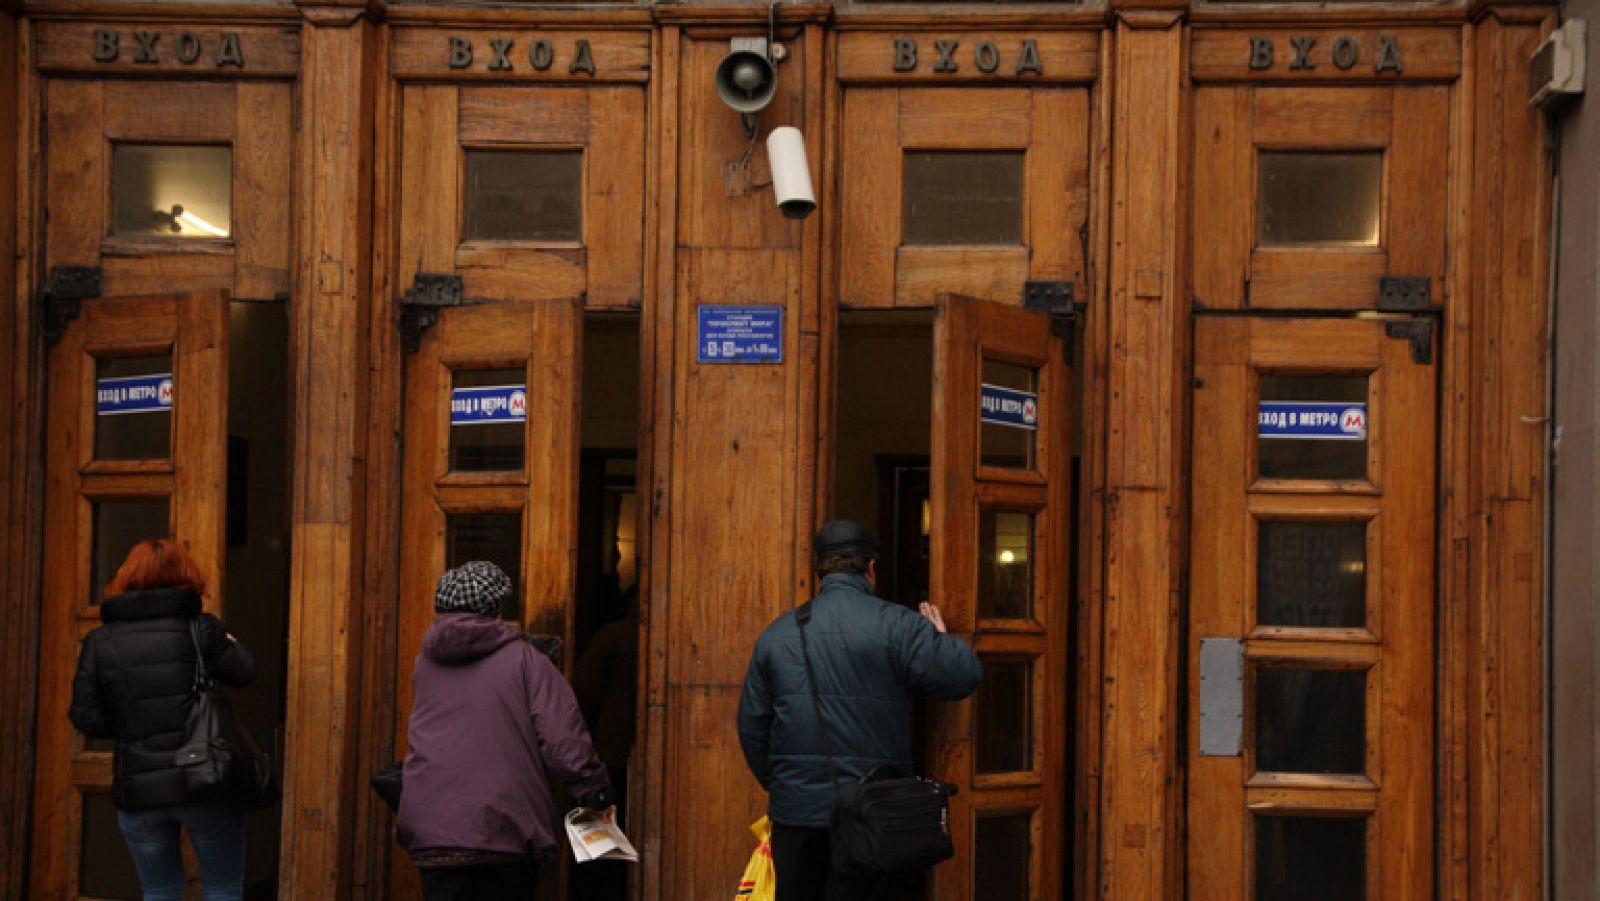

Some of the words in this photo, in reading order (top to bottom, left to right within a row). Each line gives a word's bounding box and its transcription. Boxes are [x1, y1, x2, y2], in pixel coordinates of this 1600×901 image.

[94, 29, 245, 67] ВХОД
[448, 36, 596, 76] ВХОД
[894, 38, 1044, 76] ВХОД
[1249, 35, 1403, 75] ВХОД
[1299, 412, 1339, 427] МЕТРО
